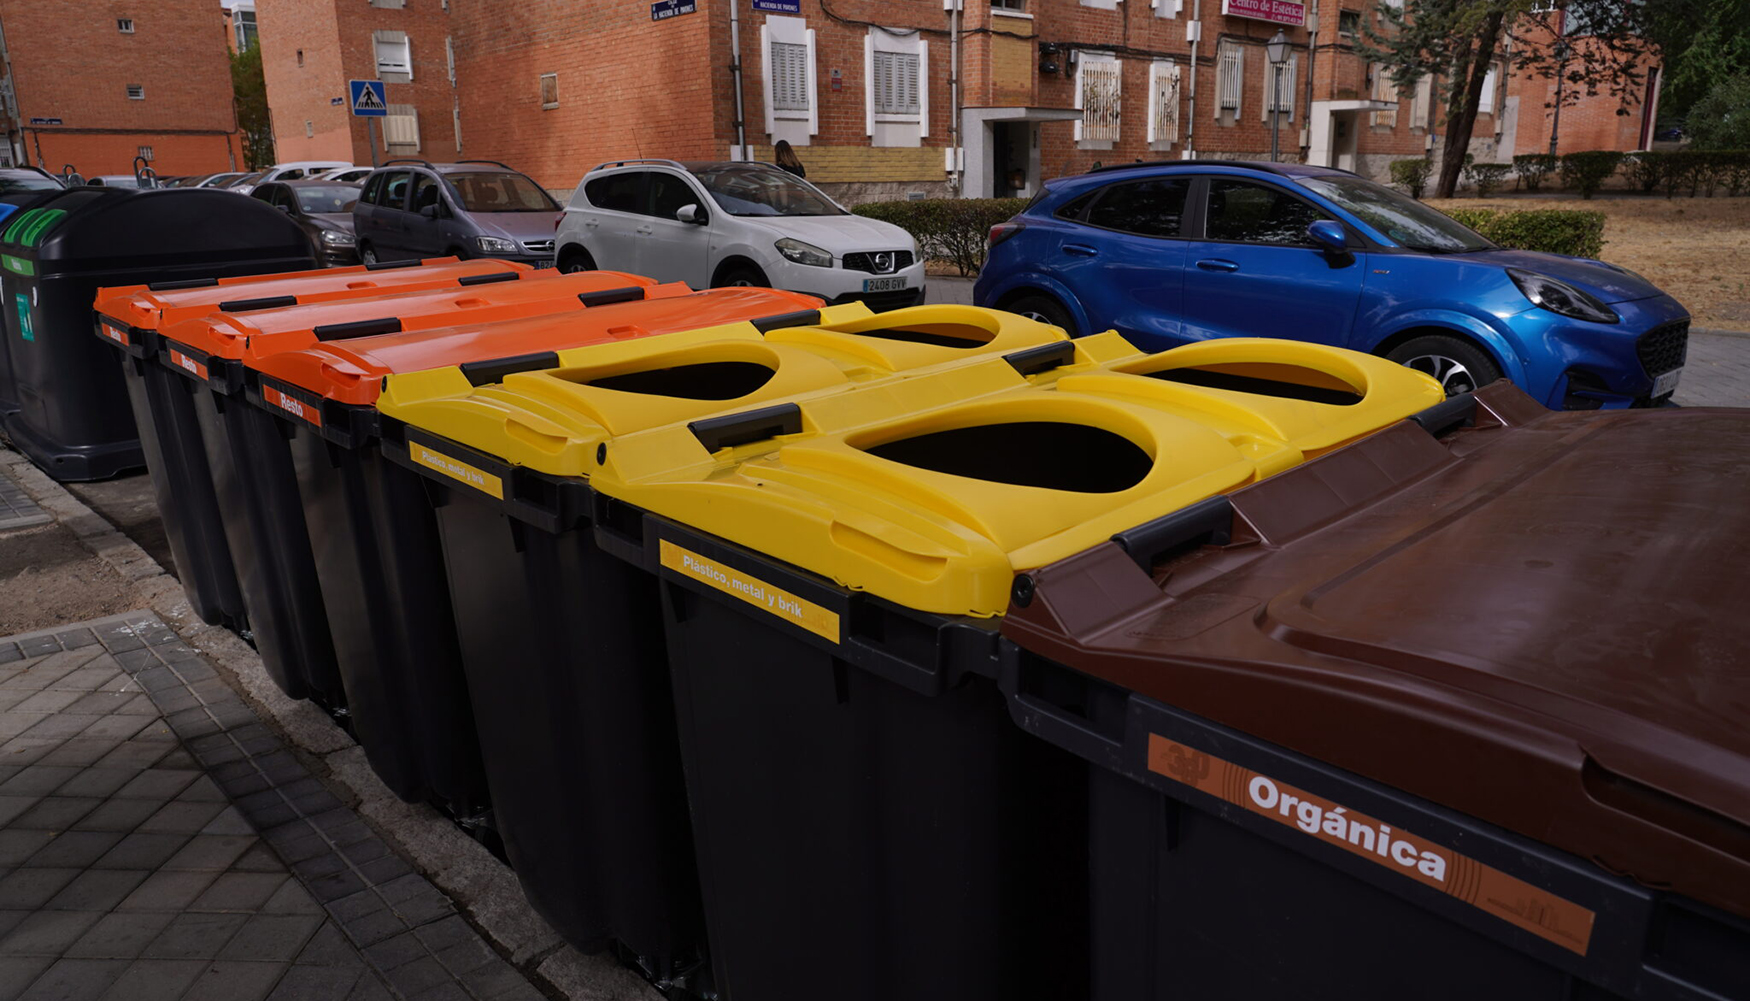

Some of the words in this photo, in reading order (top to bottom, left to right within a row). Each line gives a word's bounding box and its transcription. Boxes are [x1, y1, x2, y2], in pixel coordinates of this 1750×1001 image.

[674, 7, 679, 15] DE
[760, 1, 776, 9] HACIENDA
[1260, 0, 1270, 11] de
[1272, 1, 1303, 17] Estética
[869, 280, 890, 291] 2408
[181, 353, 197, 374] Resto
[280, 392, 303, 417] Resto
[448, 463, 465, 477] metal
[466, 471, 471, 481] y
[471, 471, 485, 485] brik
[683, 555, 731, 588] Plástico,
[732, 577, 764, 601] metal
[768, 593, 775, 606] y
[778, 596, 803, 618] brik
[1248, 776, 1447, 882] Orgánica
